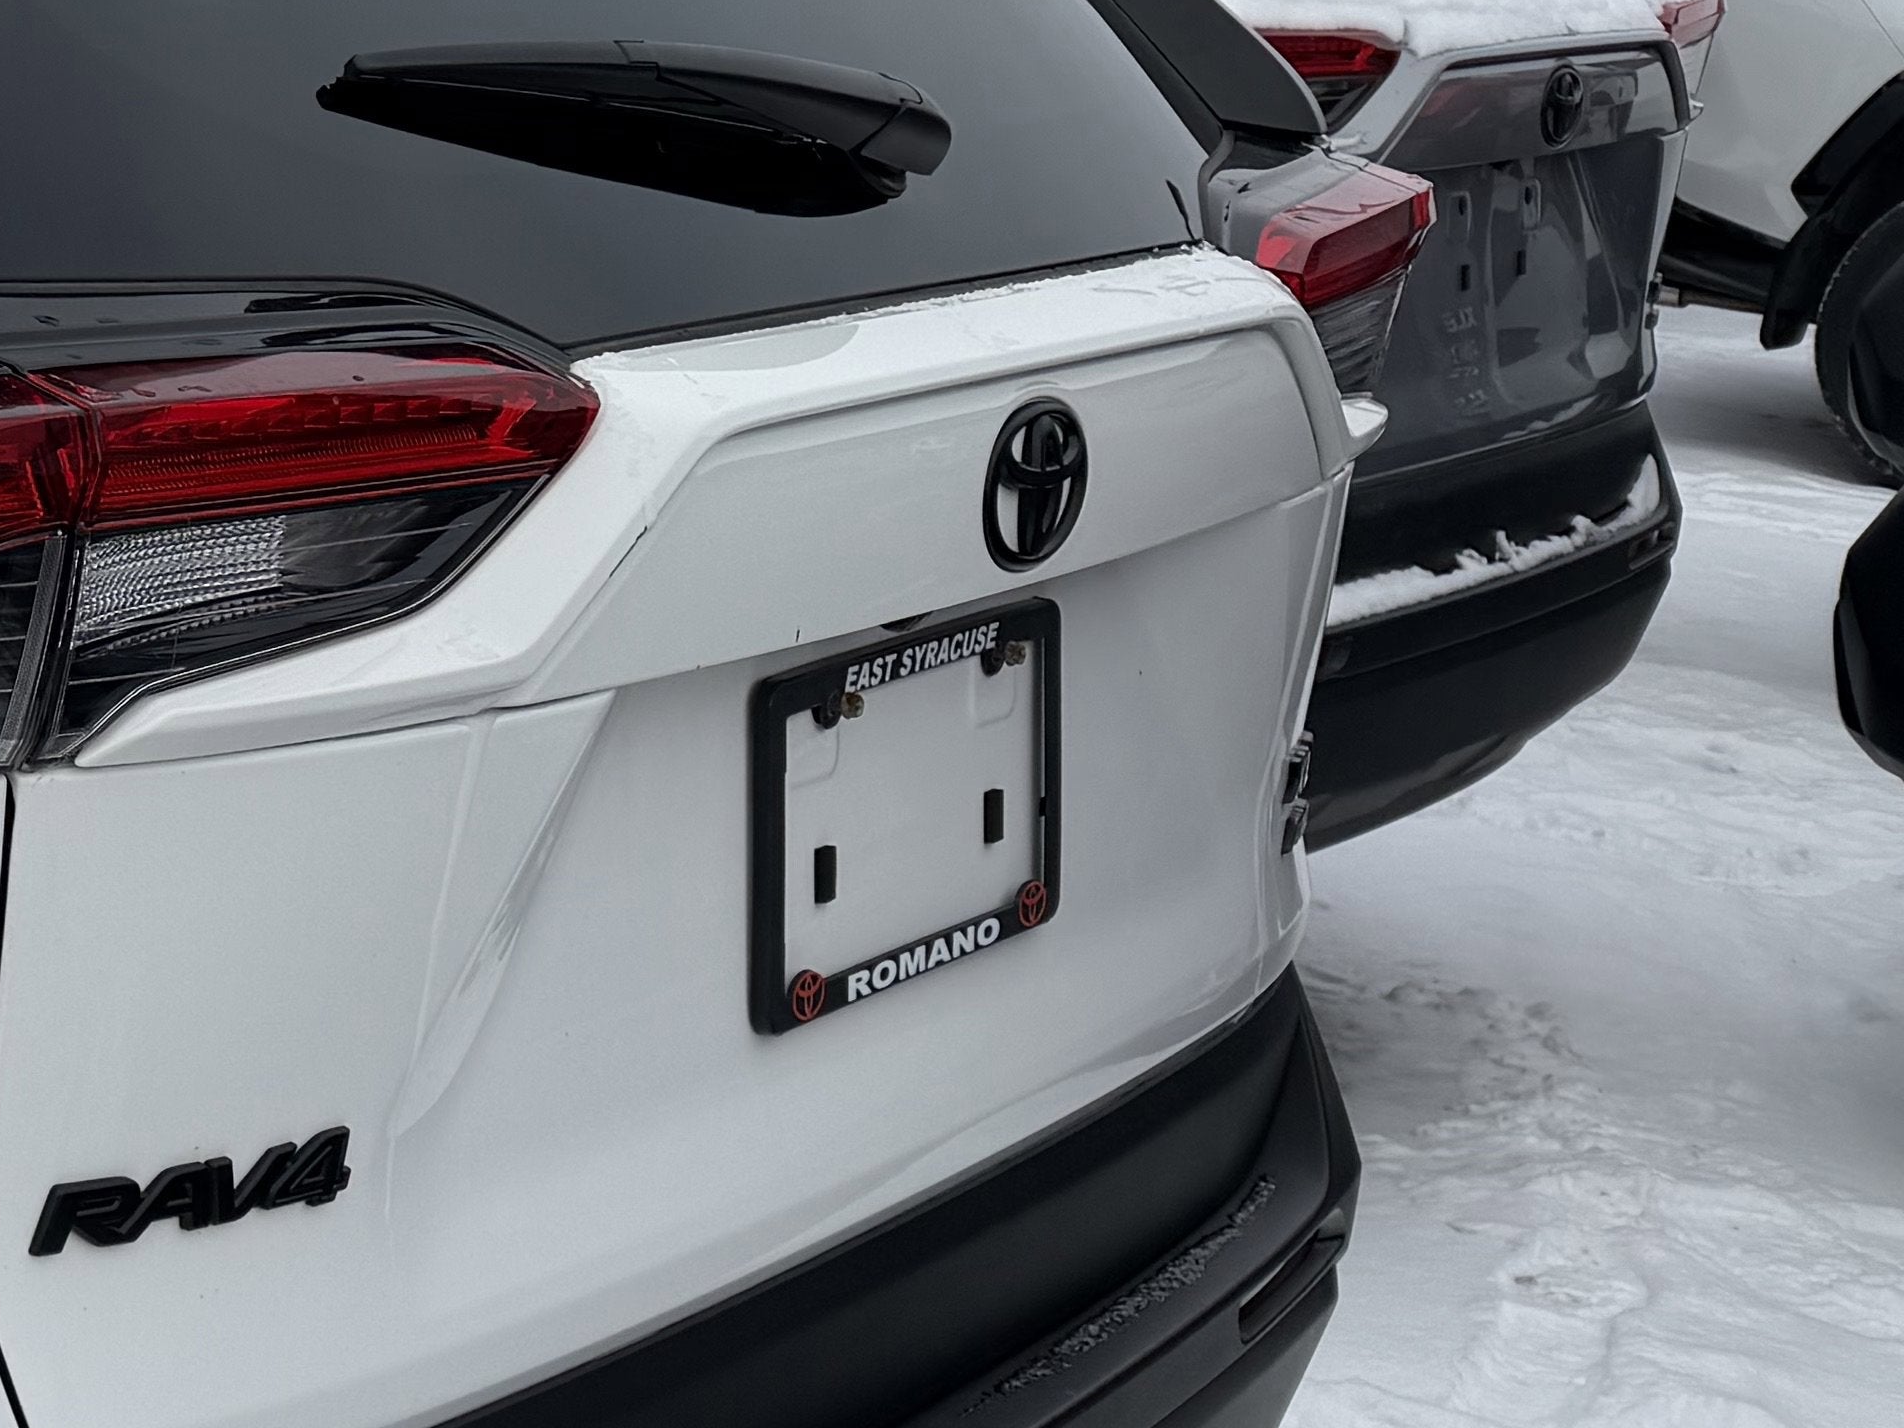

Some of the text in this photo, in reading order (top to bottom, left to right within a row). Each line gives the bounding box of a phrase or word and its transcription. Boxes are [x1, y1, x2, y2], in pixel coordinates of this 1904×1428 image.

[844, 621, 1000, 694] EAST SYRACUSE
[847, 916, 1002, 1003] ROMANO
[28, 1125, 352, 1257] RAV4
